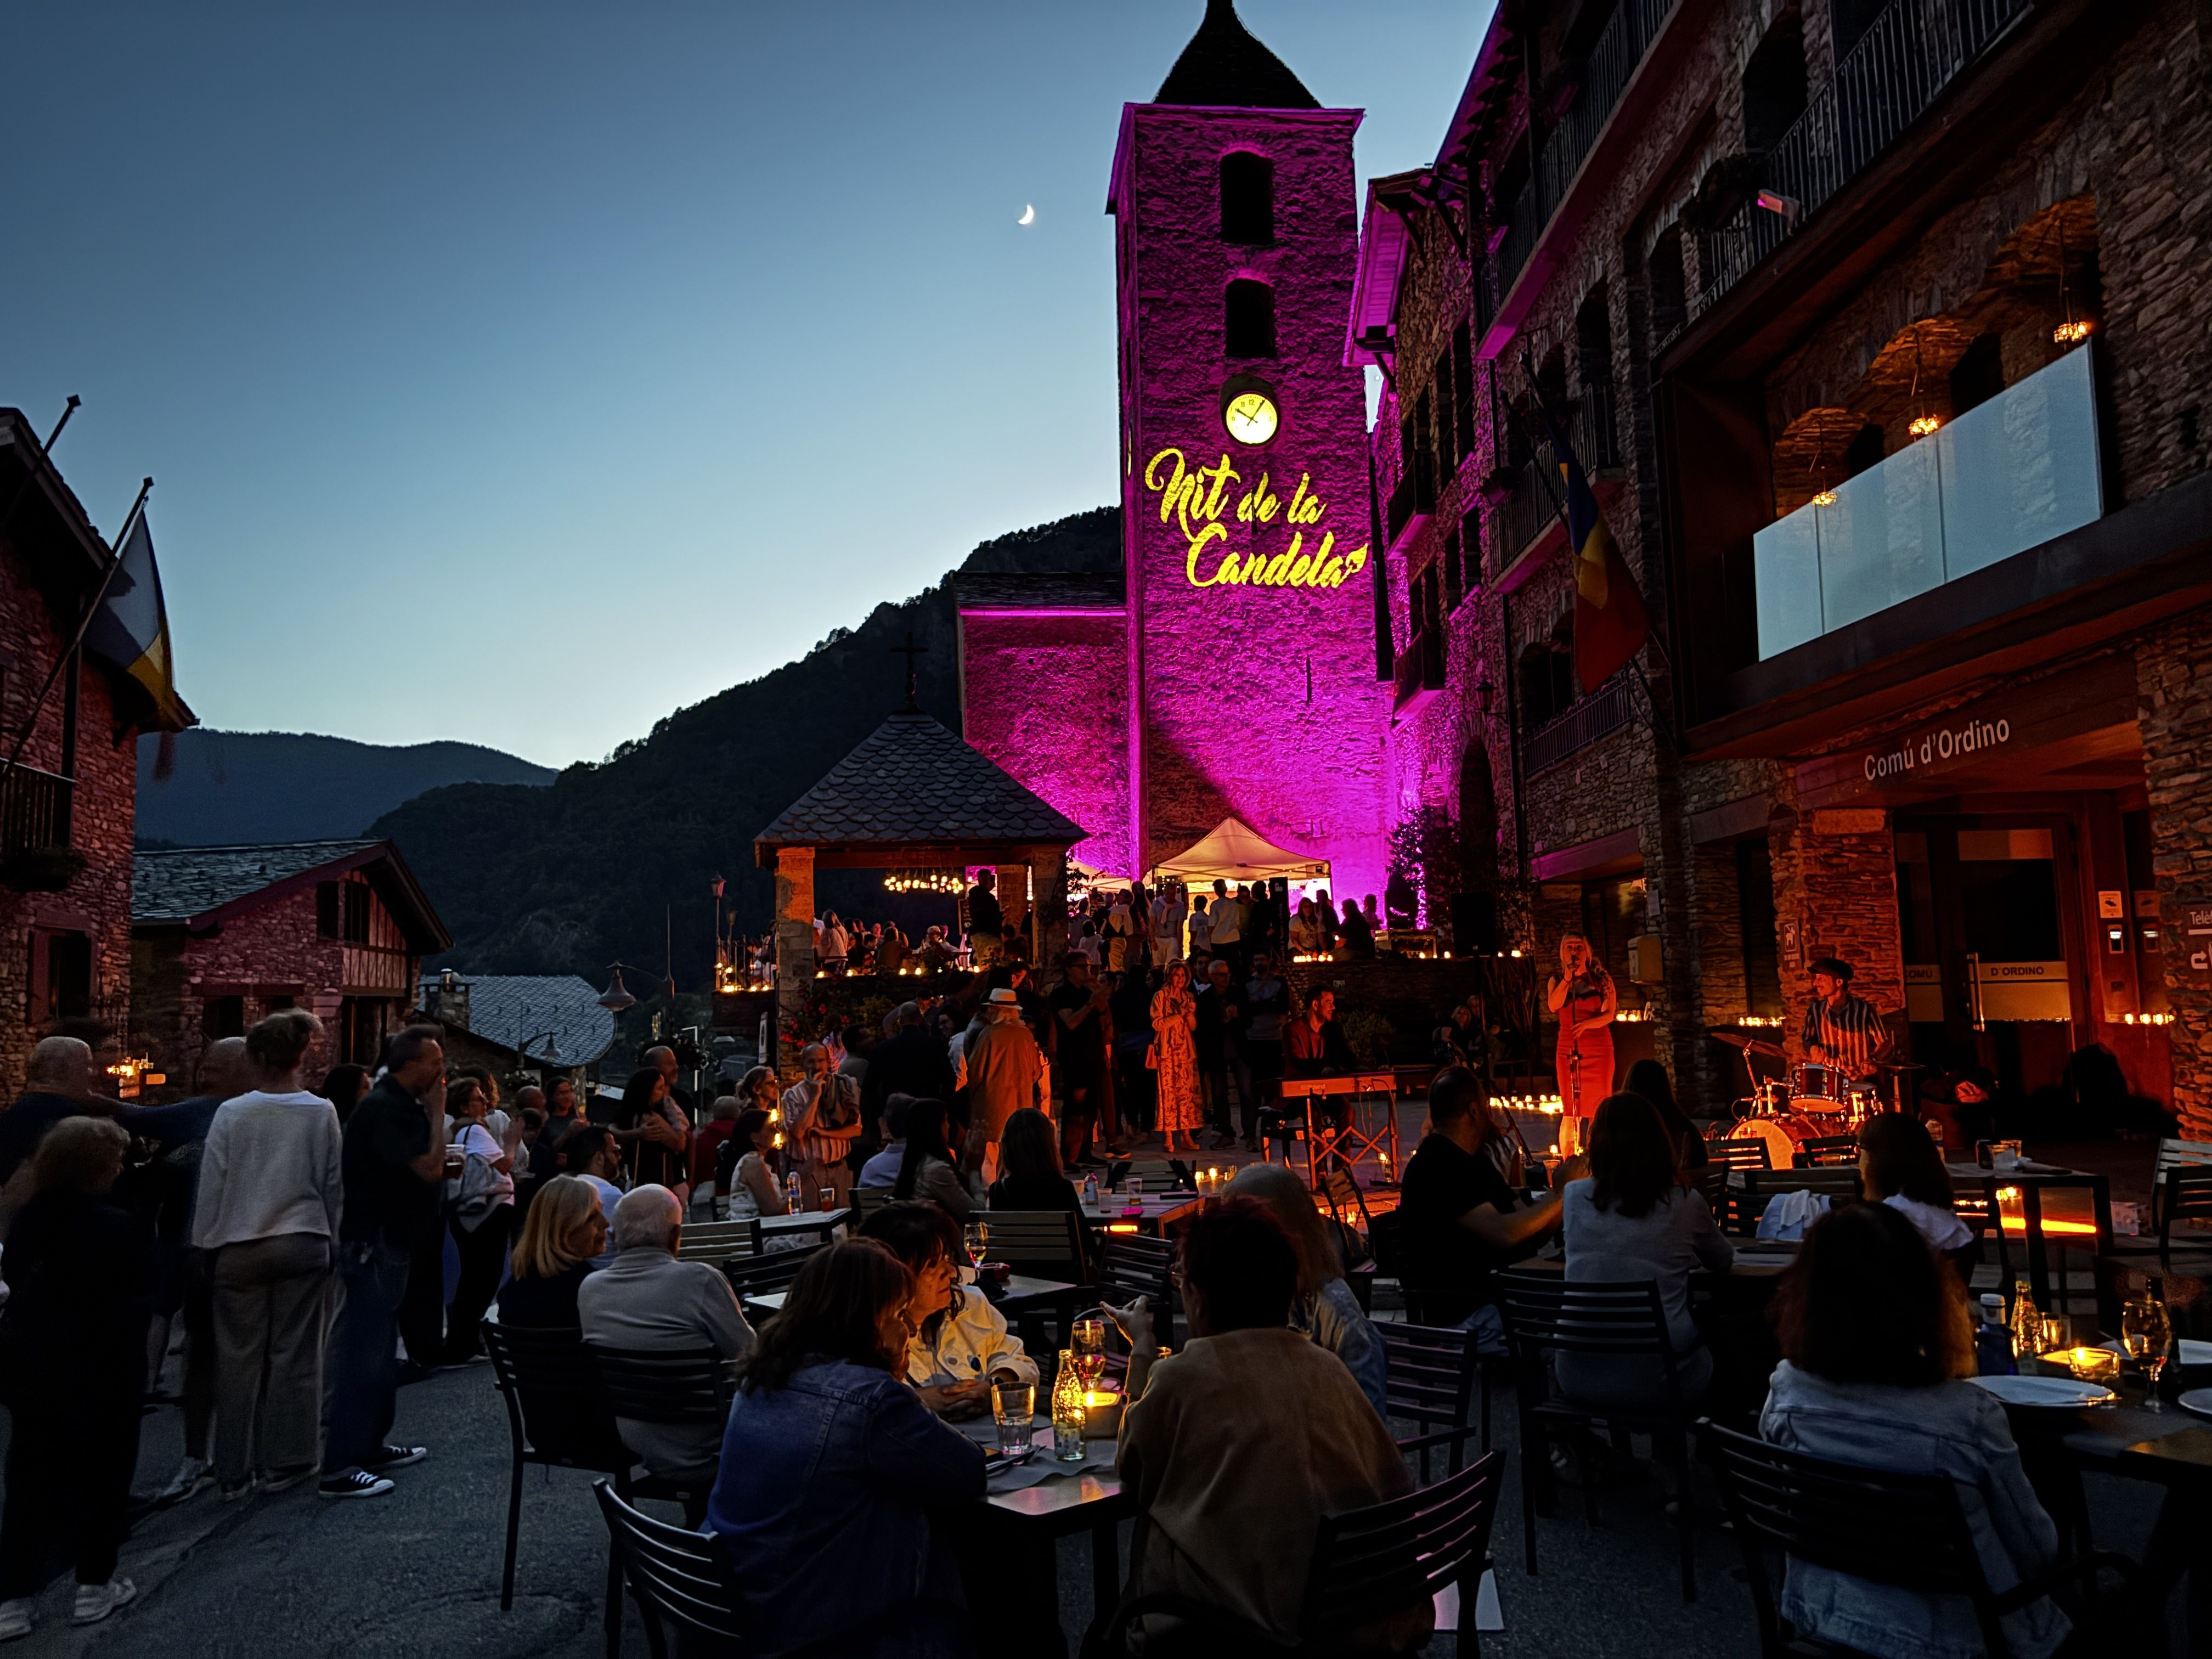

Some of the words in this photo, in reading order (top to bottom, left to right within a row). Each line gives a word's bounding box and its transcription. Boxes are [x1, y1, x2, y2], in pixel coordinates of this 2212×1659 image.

[1145, 448, 1242, 538] Nit
[1237, 472, 1282, 523] de
[1287, 472, 1327, 524] la
[1186, 522, 1352, 588] Candela
[1864, 738, 1915, 781] Comú
[1920, 718, 2010, 765] d'Ordino
